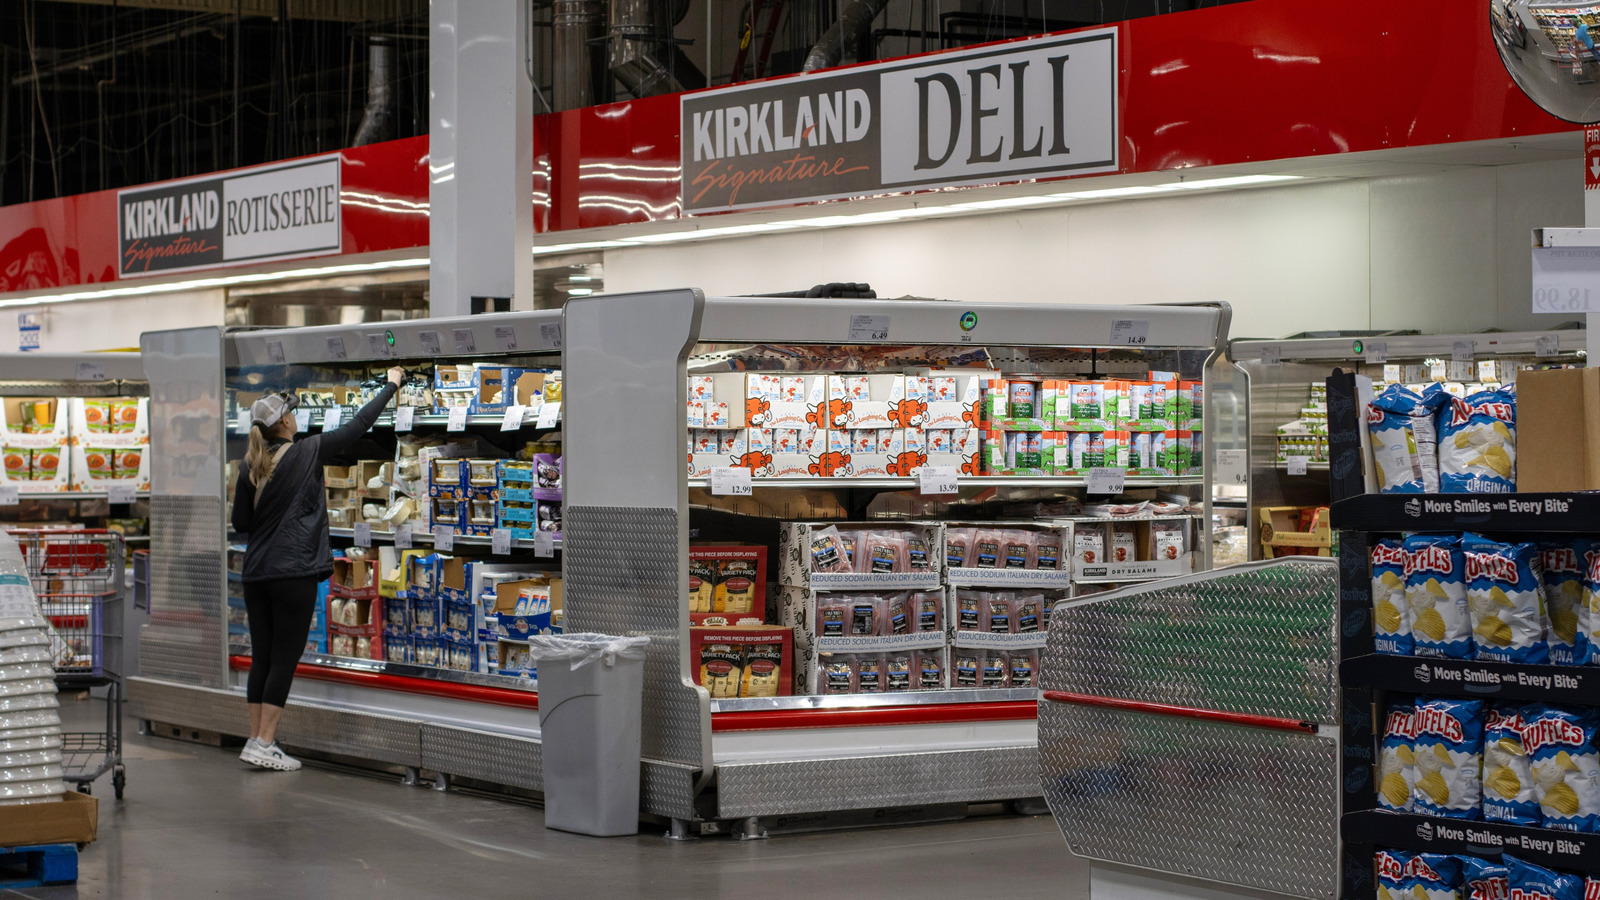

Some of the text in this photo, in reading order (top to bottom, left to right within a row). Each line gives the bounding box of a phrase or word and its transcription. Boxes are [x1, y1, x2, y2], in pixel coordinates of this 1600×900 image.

[914, 54, 1070, 171] DELI
[693, 88, 871, 162] KIRKLAND
[692, 153, 869, 207] Signature
[125, 190, 220, 240] KIRKLAND
[226, 184, 335, 236] ROTISSERIE
[124, 235, 218, 273] Signature
[872, 332, 888, 340] 6.49
[1128, 336, 1146, 344] 14.49
[777, 415, 796, 424] Laughing
[859, 414, 878, 423] Laughing
[935, 414, 953, 423] Laughing
[731, 485, 751, 494] 12.99
[939, 484, 957, 492] 13.99
[1108, 484, 1122, 492] 9.99
[1424, 500, 1452, 512] More
[1454, 499, 1491, 512] Smiles
[1493, 502, 1507, 510] with
[1509, 500, 1542, 514] Every
[811, 575, 843, 583] REDUCED
[844, 574, 872, 582] SODIUM
[912, 573, 937, 581] SALAME
[980, 571, 1006, 579] SODIUM
[1007, 571, 1029, 579] ITALIAN
[880, 636, 903, 644] ITALIAN
[904, 635, 917, 643] DRY
[1434, 666, 1462, 682] More
[1464, 669, 1501, 683] Smiles
[1502, 673, 1517, 683] with
[1518, 673, 1551, 689] Every
[1521, 719, 1584, 755] RUFFLES
[1437, 826, 1464, 841] More
[1466, 829, 1503, 845] Smiles
[1505, 836, 1519, 845] with
[1521, 836, 1553, 854] Every
